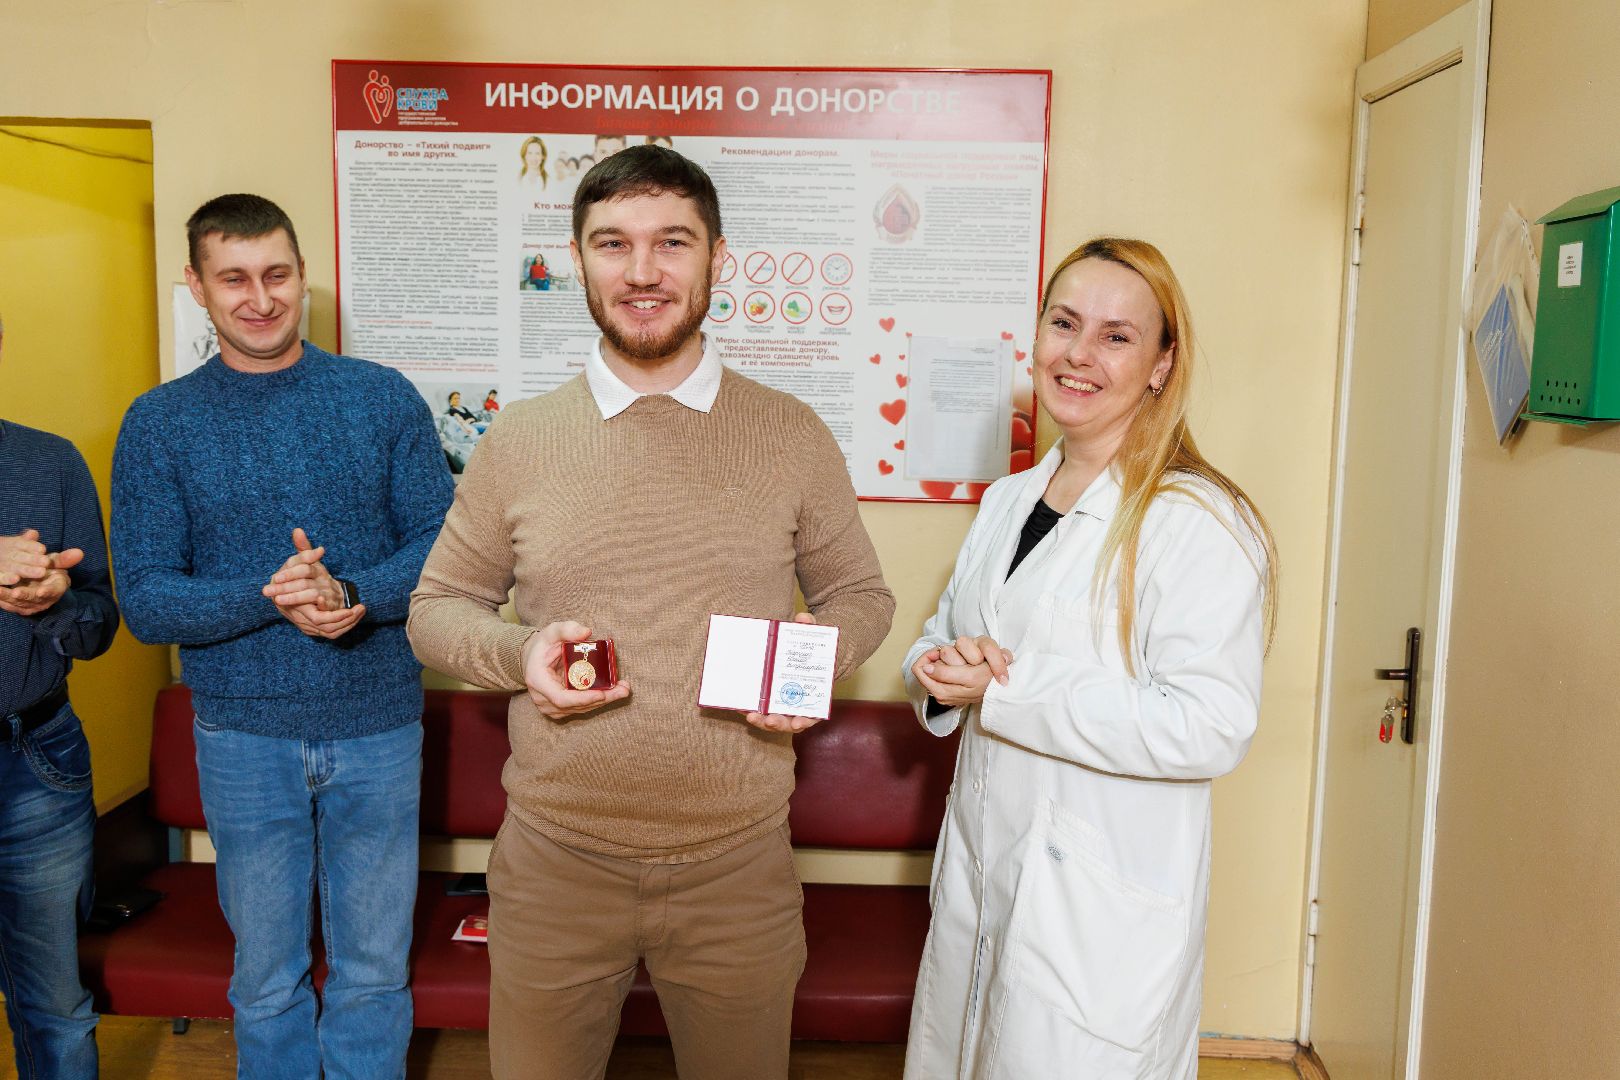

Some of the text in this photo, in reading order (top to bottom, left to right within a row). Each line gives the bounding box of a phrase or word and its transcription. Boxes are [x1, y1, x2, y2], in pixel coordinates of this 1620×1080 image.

[397, 88, 448, 100] СЛУЖБА
[485, 82, 961, 116] ИНФОРМАЦИЯ О ДОНОРСТВЕ
[397, 99, 438, 111] КРОВИ
[354, 140, 404, 149] Донорство
[416, 141, 449, 150] «Тихий
[453, 143, 491, 152] подвиг»
[423, 151, 458, 159] других.
[721, 146, 840, 159] Рекомендации донорам.
[716, 337, 738, 345] Меры
[741, 337, 789, 346] социальной
[724, 345, 796, 353] предоставляемые
[719, 353, 771, 361] езвозмездно
[773, 353, 814, 362] сдавшему
